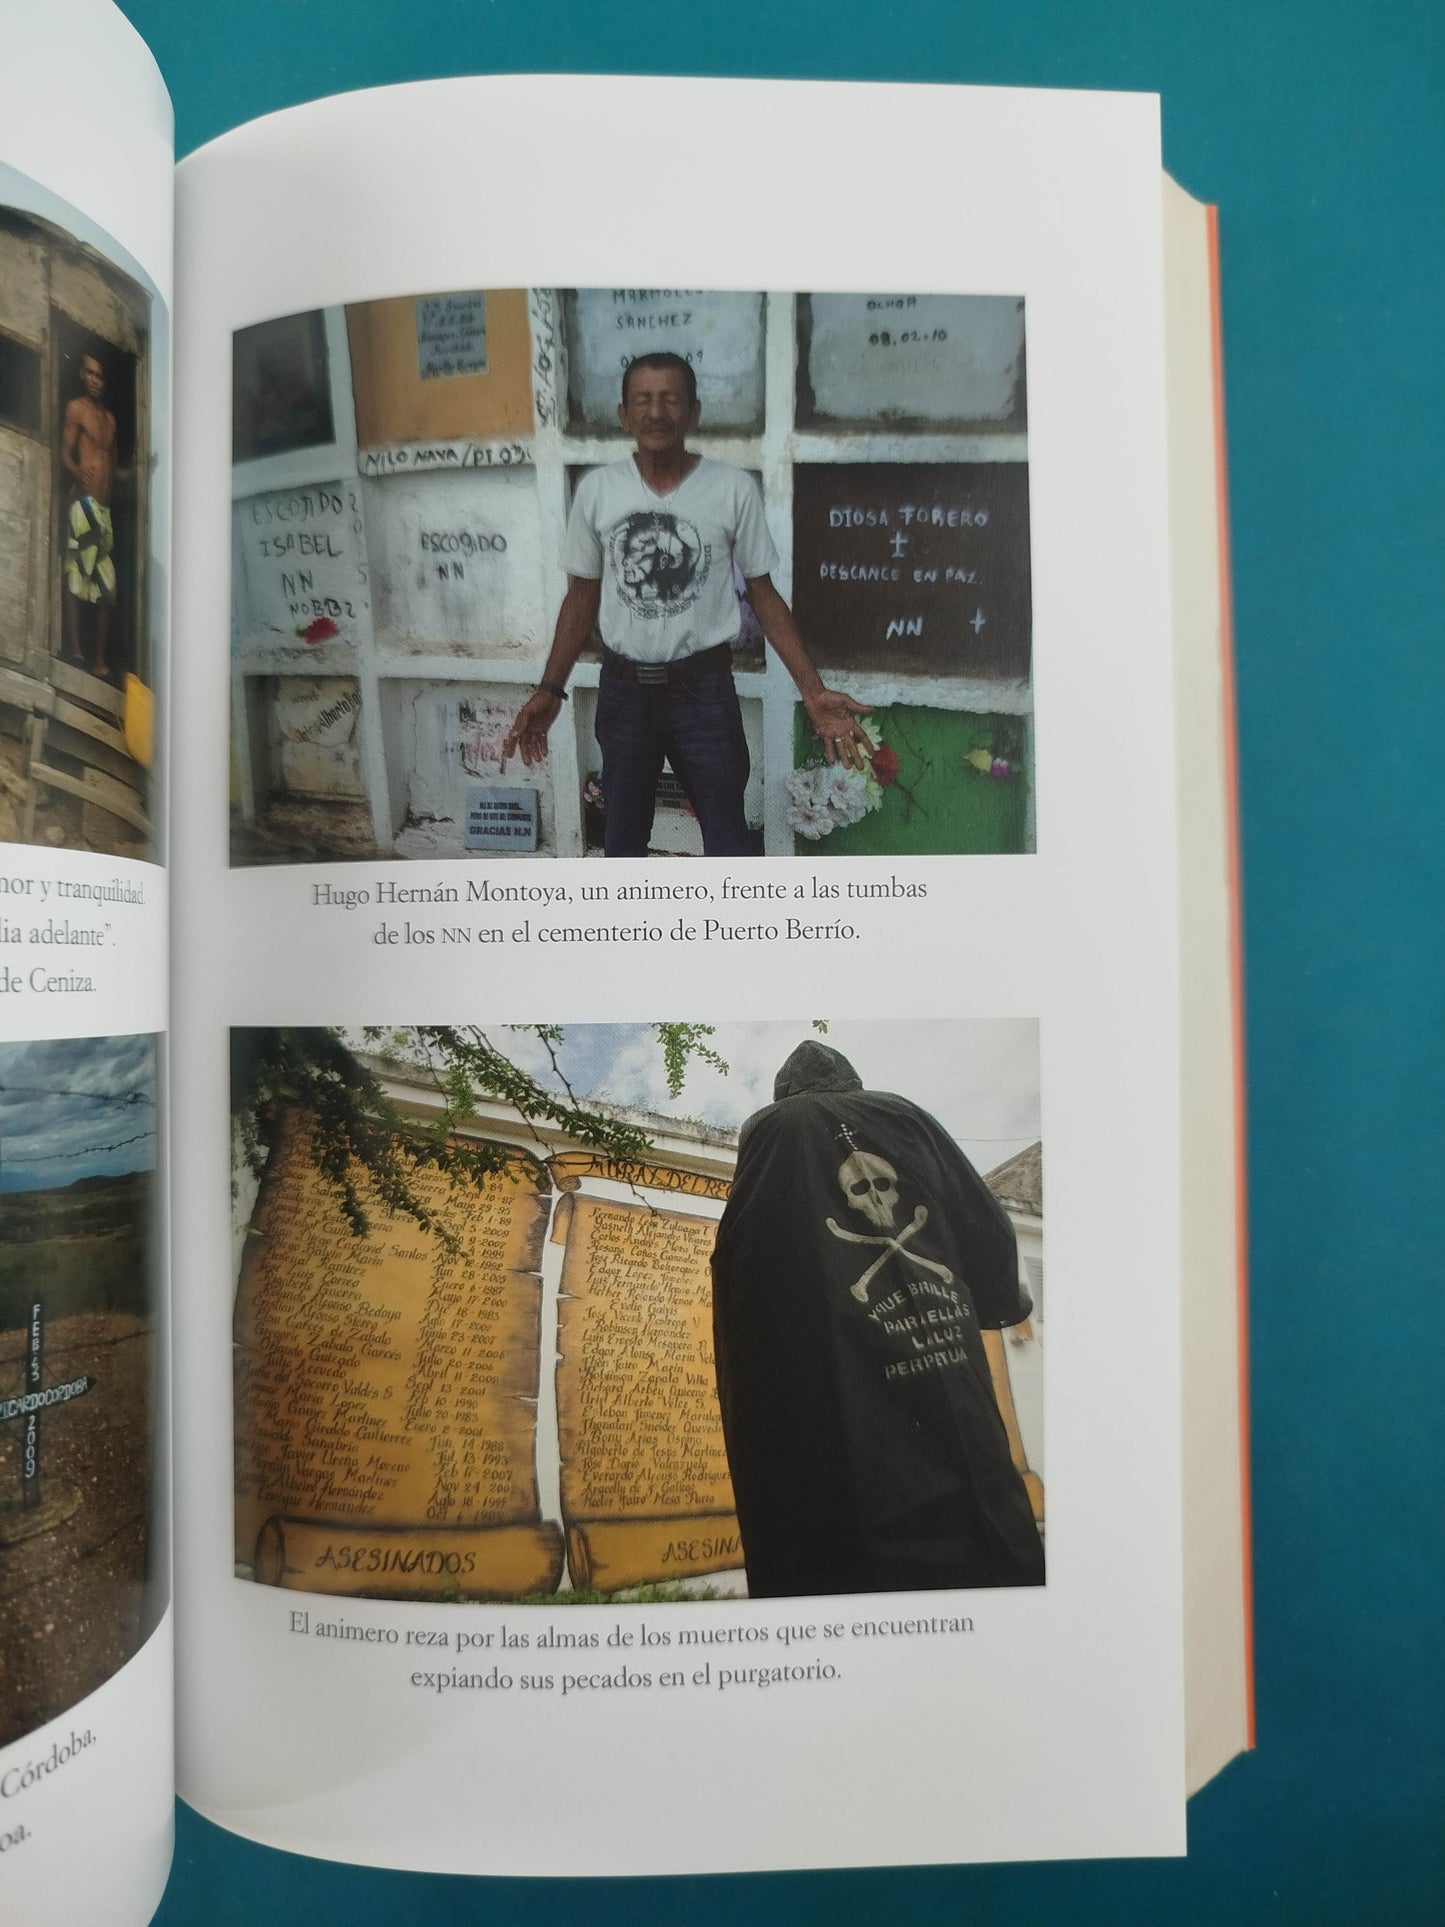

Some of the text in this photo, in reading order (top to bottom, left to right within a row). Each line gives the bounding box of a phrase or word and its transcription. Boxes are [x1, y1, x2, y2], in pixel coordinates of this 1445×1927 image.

[616, 313, 692, 330] SANCHEZ
[829, 506, 890, 528] DIOSA
[281, 567, 314, 600] NN
[437, 560, 466, 582] NN
[912, 567, 938, 584] EN
[886, 616, 923, 640] NN
[470, 826, 511, 838] GRACIAS
[40, 880, 51, 903] y
[57, 878, 147, 907] tranquilidad.
[313, 875, 928, 911] Hugo Hernán Montoya, un animero, frente a las tumbas
[373, 917, 861, 945] de los NN en el cementerio de Puerto Berrío.
[29, 966, 97, 993] Ceniza.
[315, 1544, 477, 1574] ASESINADOS
[288, 1609, 975, 1653] El animero reza por las almas de los muertos que se encuentran
[410, 1657, 842, 1695] expiando sus pecados en el purgatorio.
[0, 1728, 97, 1798] Córdoba,
